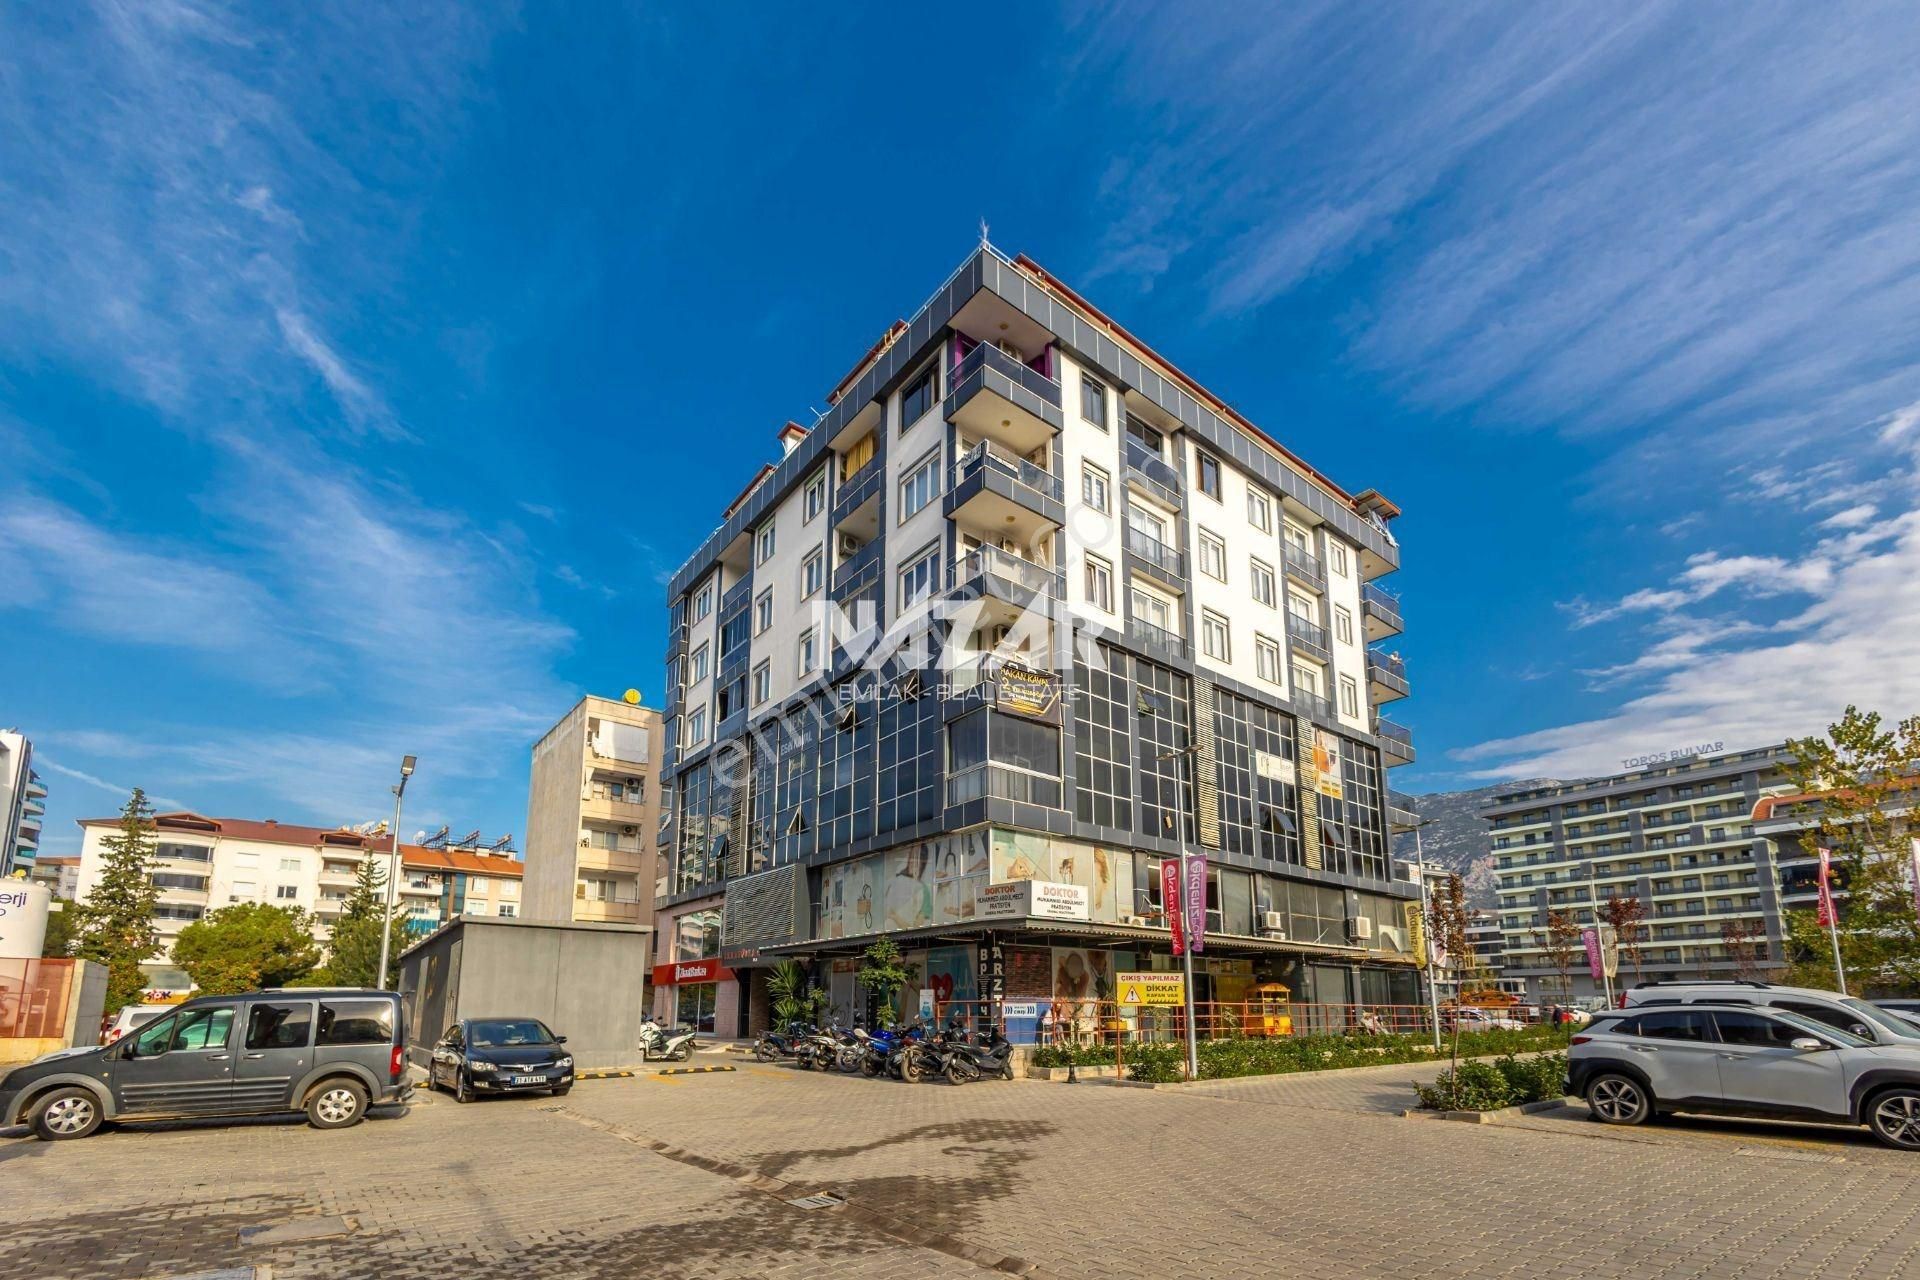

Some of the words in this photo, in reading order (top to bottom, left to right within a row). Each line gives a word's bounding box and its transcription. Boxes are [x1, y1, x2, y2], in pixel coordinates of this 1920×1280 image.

[1622, 752, 1667, 769] TOROS
[1670, 741, 1724, 761] BULVAR
[985, 885, 1016, 896] DOKTOR
[1043, 886, 1079, 899] DOKTOR
[992, 946, 1003, 1008] ARZT
[1146, 984, 1178, 992] DİKKAT
